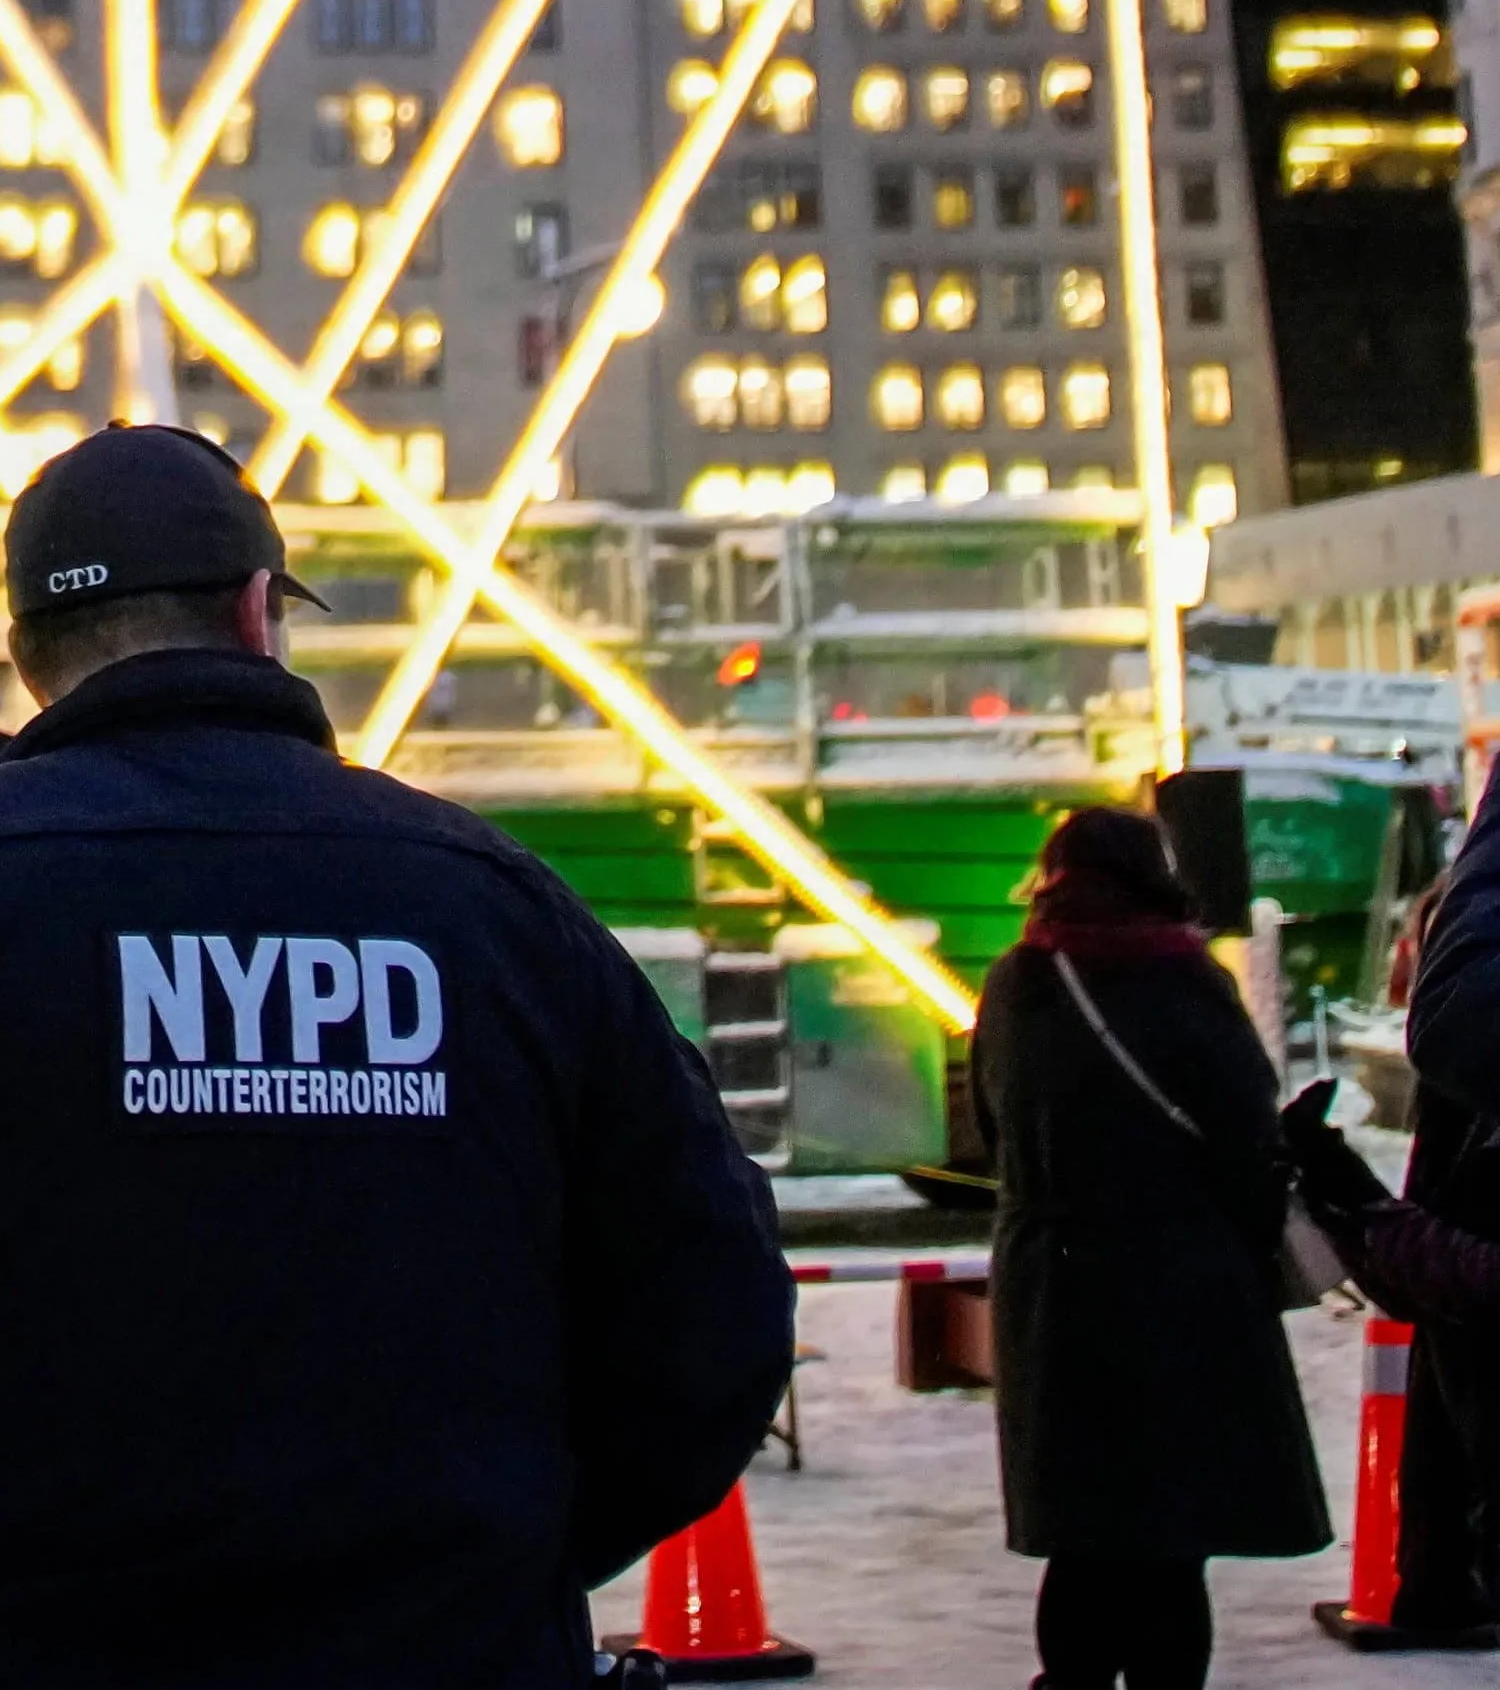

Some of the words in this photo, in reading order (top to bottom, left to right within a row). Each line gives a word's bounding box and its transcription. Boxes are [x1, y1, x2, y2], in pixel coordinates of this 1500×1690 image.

[48, 564, 108, 593] CTD
[117, 934, 443, 1064] NYPD
[123, 1067, 446, 1116] COUNTERTERRORISM
